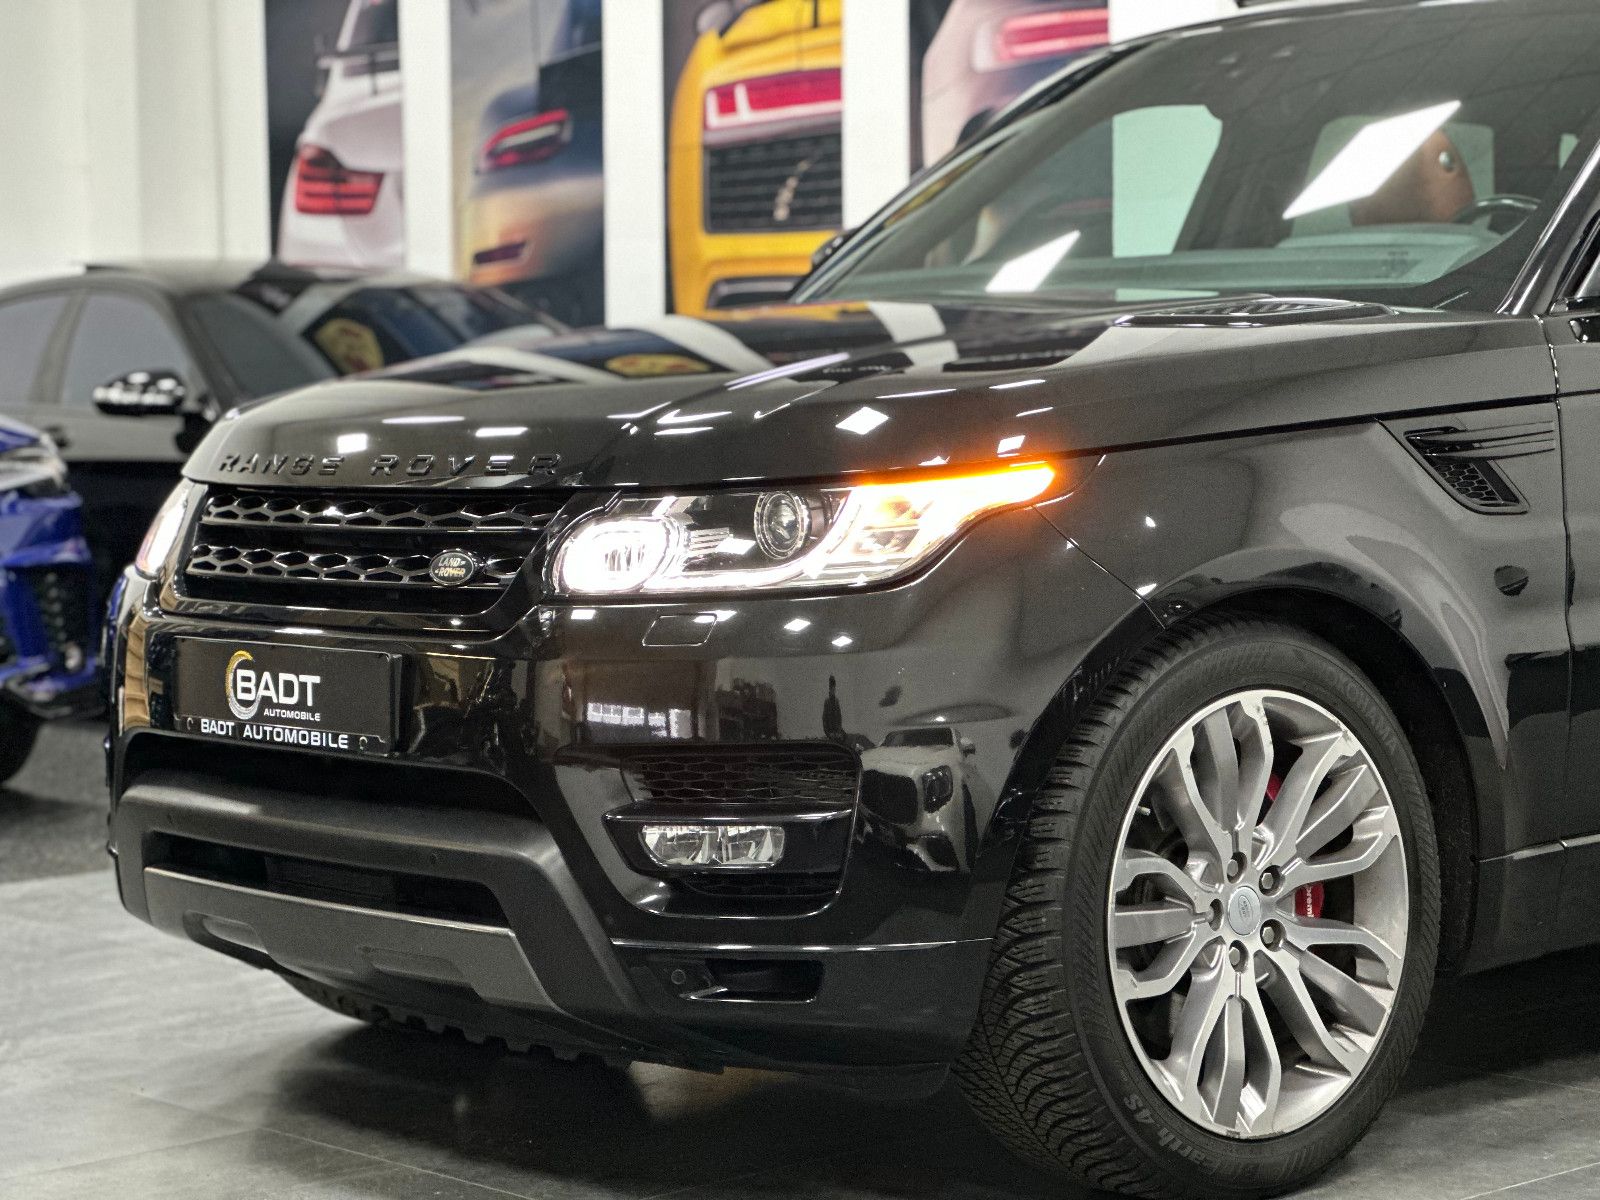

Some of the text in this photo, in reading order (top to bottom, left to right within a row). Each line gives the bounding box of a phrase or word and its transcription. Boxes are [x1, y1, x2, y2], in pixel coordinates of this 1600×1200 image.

[219, 453, 561, 476] RANGE ROVER
[438, 557, 462, 567] LAND
[438, 567, 466, 577] ROVER
[236, 668, 321, 707] BADT
[263, 708, 321, 722] AUTOMOBILE
[200, 718, 349, 750] BADT AUTOMOBILE
